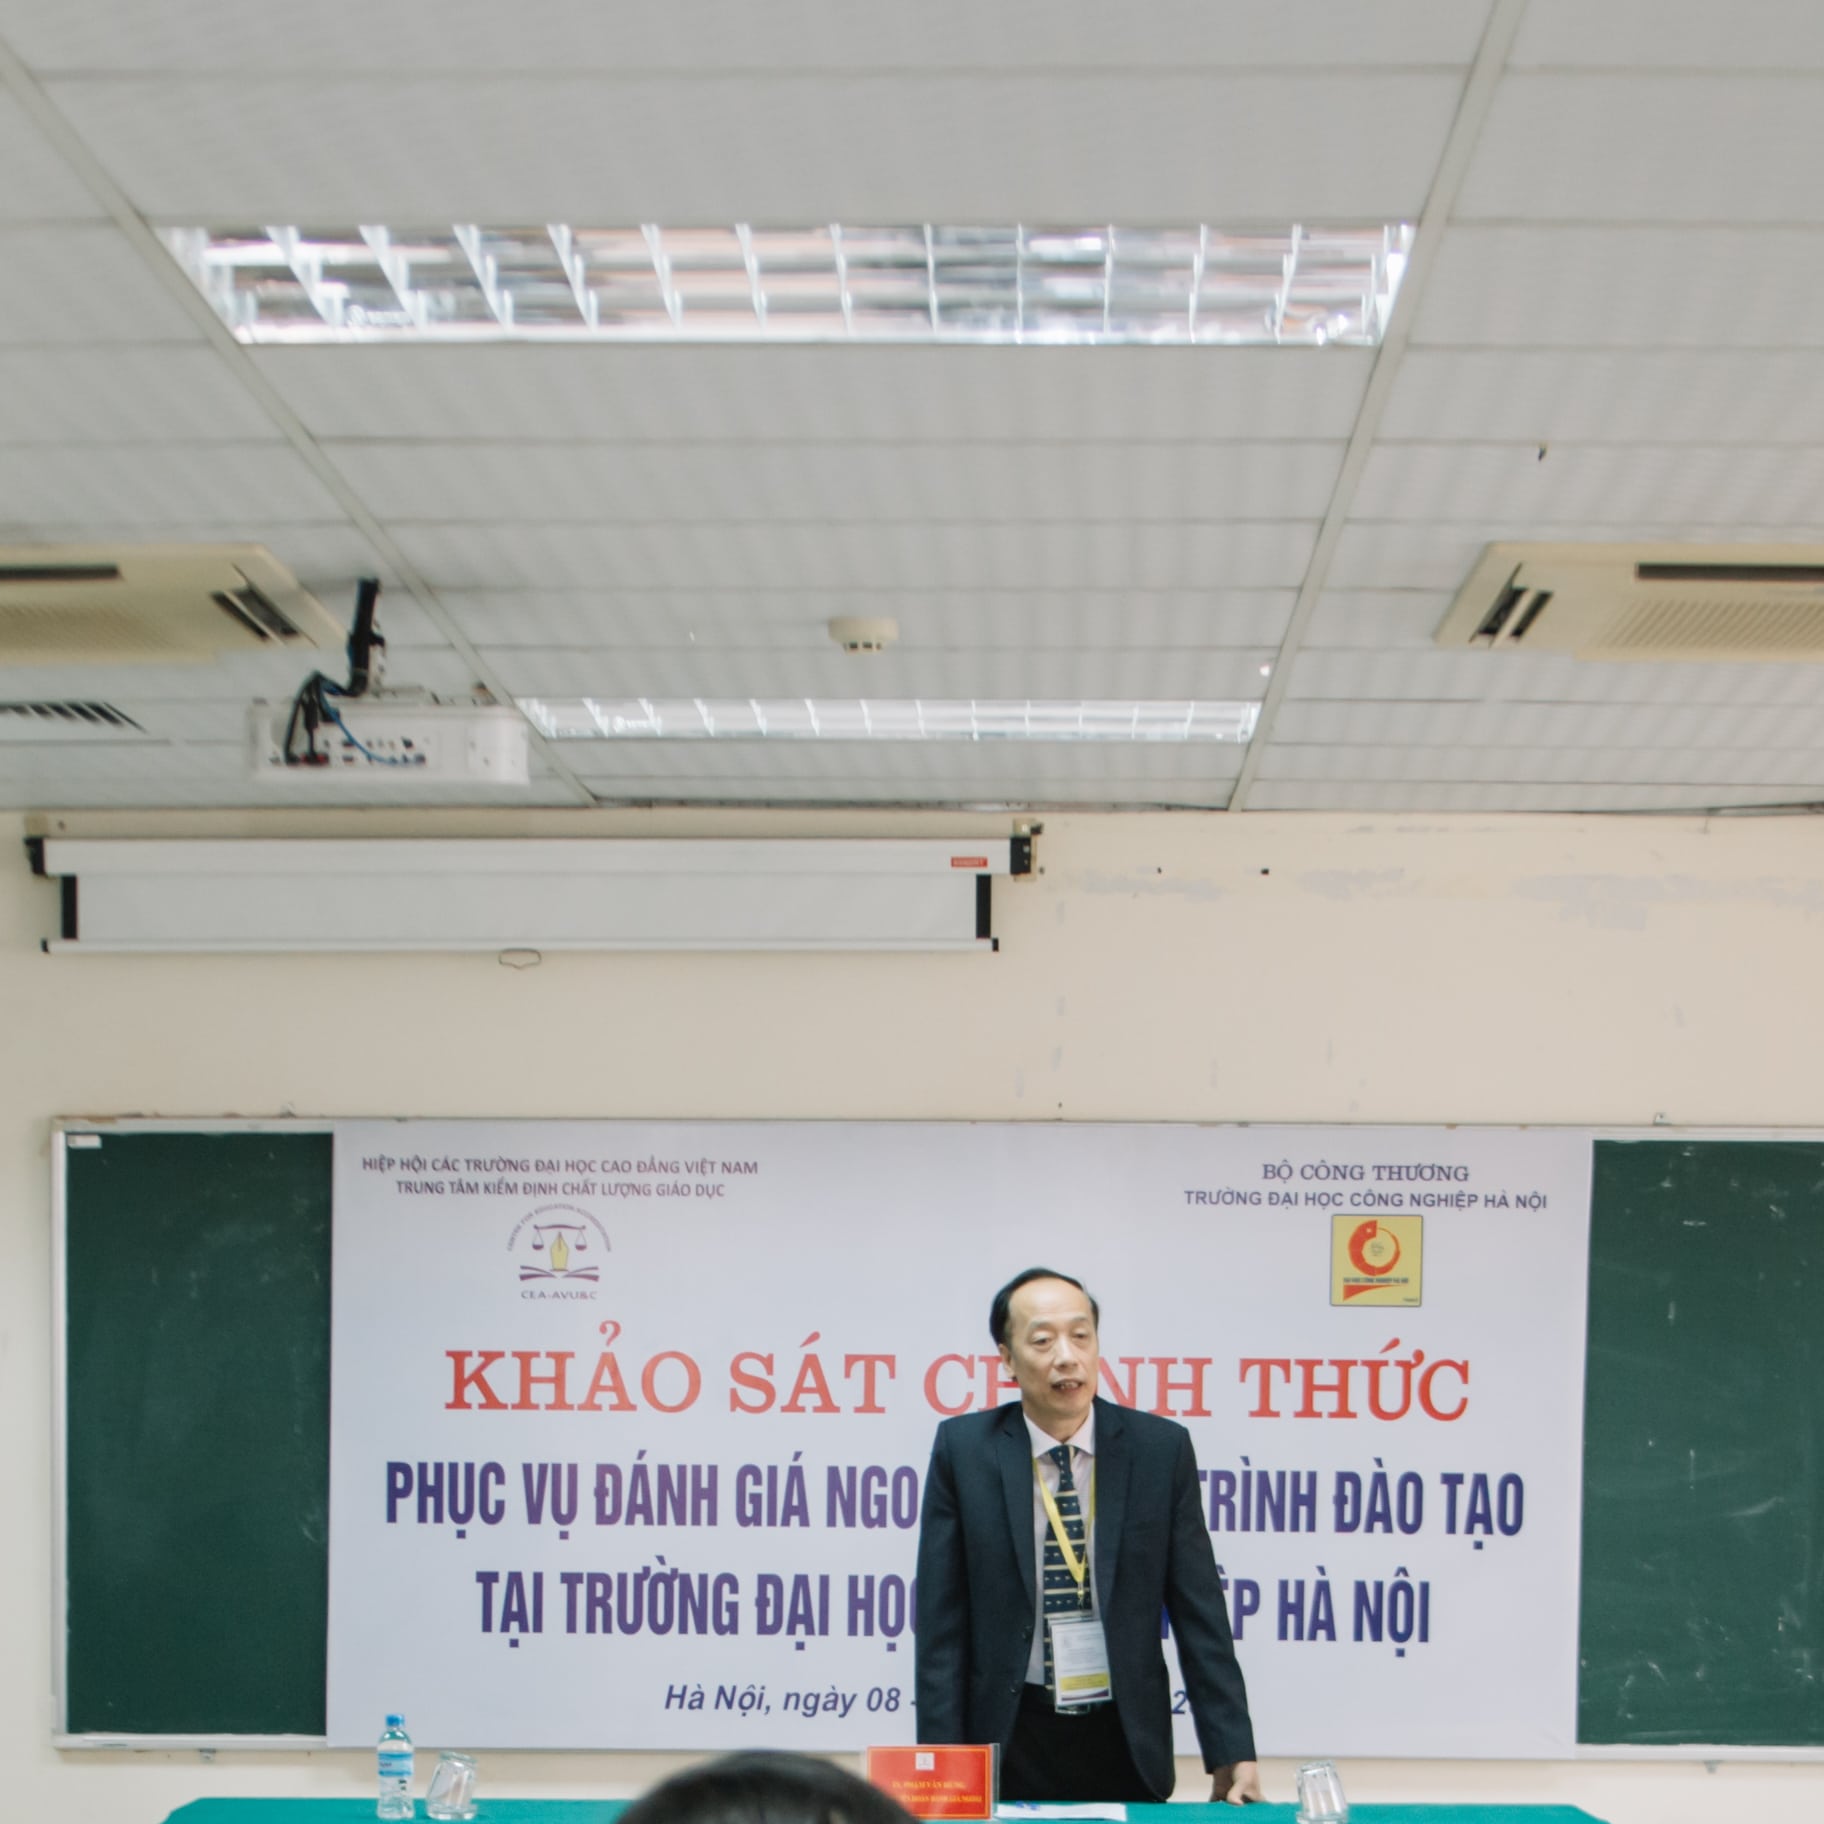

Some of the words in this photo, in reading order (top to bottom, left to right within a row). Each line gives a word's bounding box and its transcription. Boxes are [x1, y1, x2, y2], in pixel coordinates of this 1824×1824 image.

[362, 1154, 395, 1173] HIỆP
[400, 1155, 426, 1173] HỘI
[432, 1154, 460, 1172] CÁC
[465, 1156, 530, 1173] TRƯỜNG
[535, 1158, 560, 1175] ĐẠI
[565, 1158, 596, 1175] HỌC
[600, 1159, 632, 1174] CAO
[684, 1157, 716, 1176] VIỆT
[721, 1160, 758, 1174] NAM
[1262, 1159, 1293, 1184] BỘ
[1300, 1160, 1365, 1181] CÔNG
[1372, 1163, 1469, 1182] THƯƠNG
[396, 1180, 445, 1195] TRUNG
[450, 1177, 479, 1195] TÂM
[484, 1176, 518, 1195] KIỂM
[523, 1182, 557, 1198] ĐỊNH
[562, 1178, 598, 1196] CHẤT
[601, 1182, 652, 1199] LƯỢNG
[656, 1180, 691, 1197] GIÁO
[696, 1184, 725, 1199] DỤC
[1184, 1186, 1262, 1206] TRƯỜNG
[1268, 1191, 1298, 1210] ĐẠI
[1304, 1192, 1344, 1210] HỌC
[1350, 1189, 1403, 1207] CÔNG
[1410, 1190, 1478, 1211] NGHIỆP
[1484, 1190, 1509, 1208] HÀ
[1516, 1191, 1547, 1212] NỘI
[444, 1320, 701, 1413] KHẢO
[730, 1331, 896, 1414] SÁT
[923, 1353, 1212, 1417] CHNH
[1239, 1337, 1470, 1422] THỨC
[386, 1461, 506, 1539] PHỤC
[522, 1462, 578, 1540] VỤ
[593, 1449, 718, 1526] ĐÁNH
[736, 1451, 810, 1528] GIÁ
[1332, 1457, 1424, 1535] ĐÀO
[1440, 1472, 1524, 1550] TẠO
[475, 1571, 543, 1648] TẠI
[560, 1555, 739, 1636] TRƯỜNG
[755, 1573, 830, 1651] ĐẠI
[848, 1574, 917, 1652] HỌ
[1277, 1565, 1337, 1642] HÀ
[1353, 1566, 1430, 1658] NỘI
[665, 1684, 704, 1711] Hà
[714, 1684, 770, 1717] Nội,
[783, 1685, 858, 1718] ngày
[866, 1687, 901, 1712] 08
